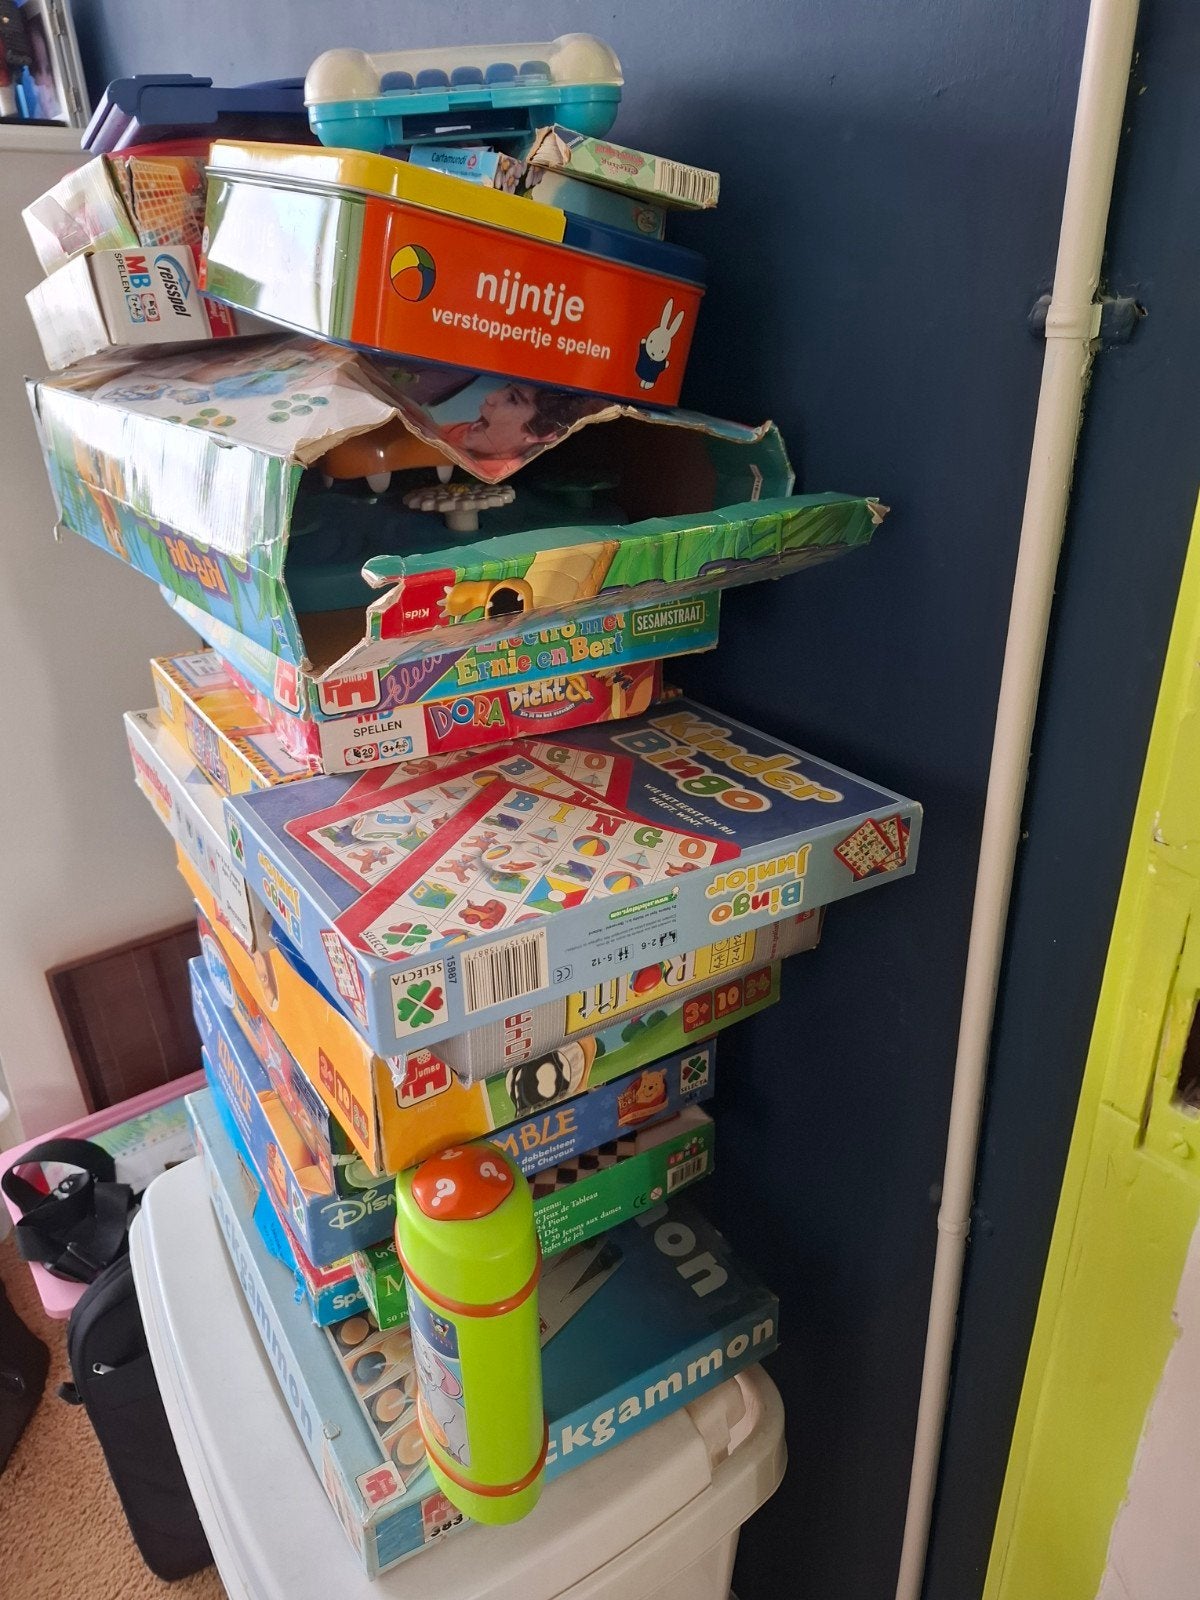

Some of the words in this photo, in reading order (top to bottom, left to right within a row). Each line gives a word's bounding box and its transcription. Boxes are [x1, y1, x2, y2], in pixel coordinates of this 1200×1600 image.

[432, 152, 466, 165] Cartamundi
[114, 253, 130, 292] SPELLEN
[124, 256, 151, 288] MB
[157, 265, 191, 317] reisspel
[476, 268, 584, 326] nijntje
[432, 307, 552, 349] verstoppertje
[557, 335, 611, 360] spelen
[405, 608, 430, 619] Kids
[636, 606, 701, 631] SESAMSTRAAT
[456, 649, 531, 685] Ernie
[537, 646, 568, 668] en
[569, 630, 624, 662] Bert
[508, 686, 565, 712] Dicht
[353, 720, 402, 738] SPELLEN
[428, 698, 504, 739] DORA
[361, 748, 374, 756] 20
[382, 745, 394, 753] 3+
[650, 711, 843, 803] Kinder
[611, 729, 772, 812] Bingo
[644, 784, 661, 794] WIE
[660, 793, 679, 803] HET
[676, 802, 704, 817] EERST
[700, 816, 721, 827] EEN
[705, 843, 812, 898] Junior
[709, 880, 803, 925] Bingo
[363, 931, 389, 956] SELECTA
[392, 963, 444, 985] SELECTA
[445, 955, 458, 985] 15887
[717, 986, 740, 1011] 10
[412, 1063, 441, 1082] JUMBO
[680, 1079, 708, 1093] SELECTA
[492, 1108, 578, 1157] MBLE
[521, 1138, 576, 1166] dobbelsteen
[521, 1164, 536, 1174] tits
[538, 1147, 574, 1167] Chevaux
[320, 1190, 397, 1230] Disn
[534, 1201, 562, 1217] ontenu:
[541, 1210, 558, 1224] Jeux
[560, 1205, 570, 1214] de
[571, 1192, 599, 1208] Tableau
[549, 1214, 569, 1228] Pions
[551, 1233, 561, 1243] 20
[562, 1223, 585, 1238] Jetons
[586, 1217, 598, 1225] aux
[600, 1205, 622, 1220] dames
[563, 1235, 572, 1243] de
[654, 1222, 728, 1298] on
[332, 1290, 364, 1310] Spe
[545, 1318, 774, 1465] ckgammon
